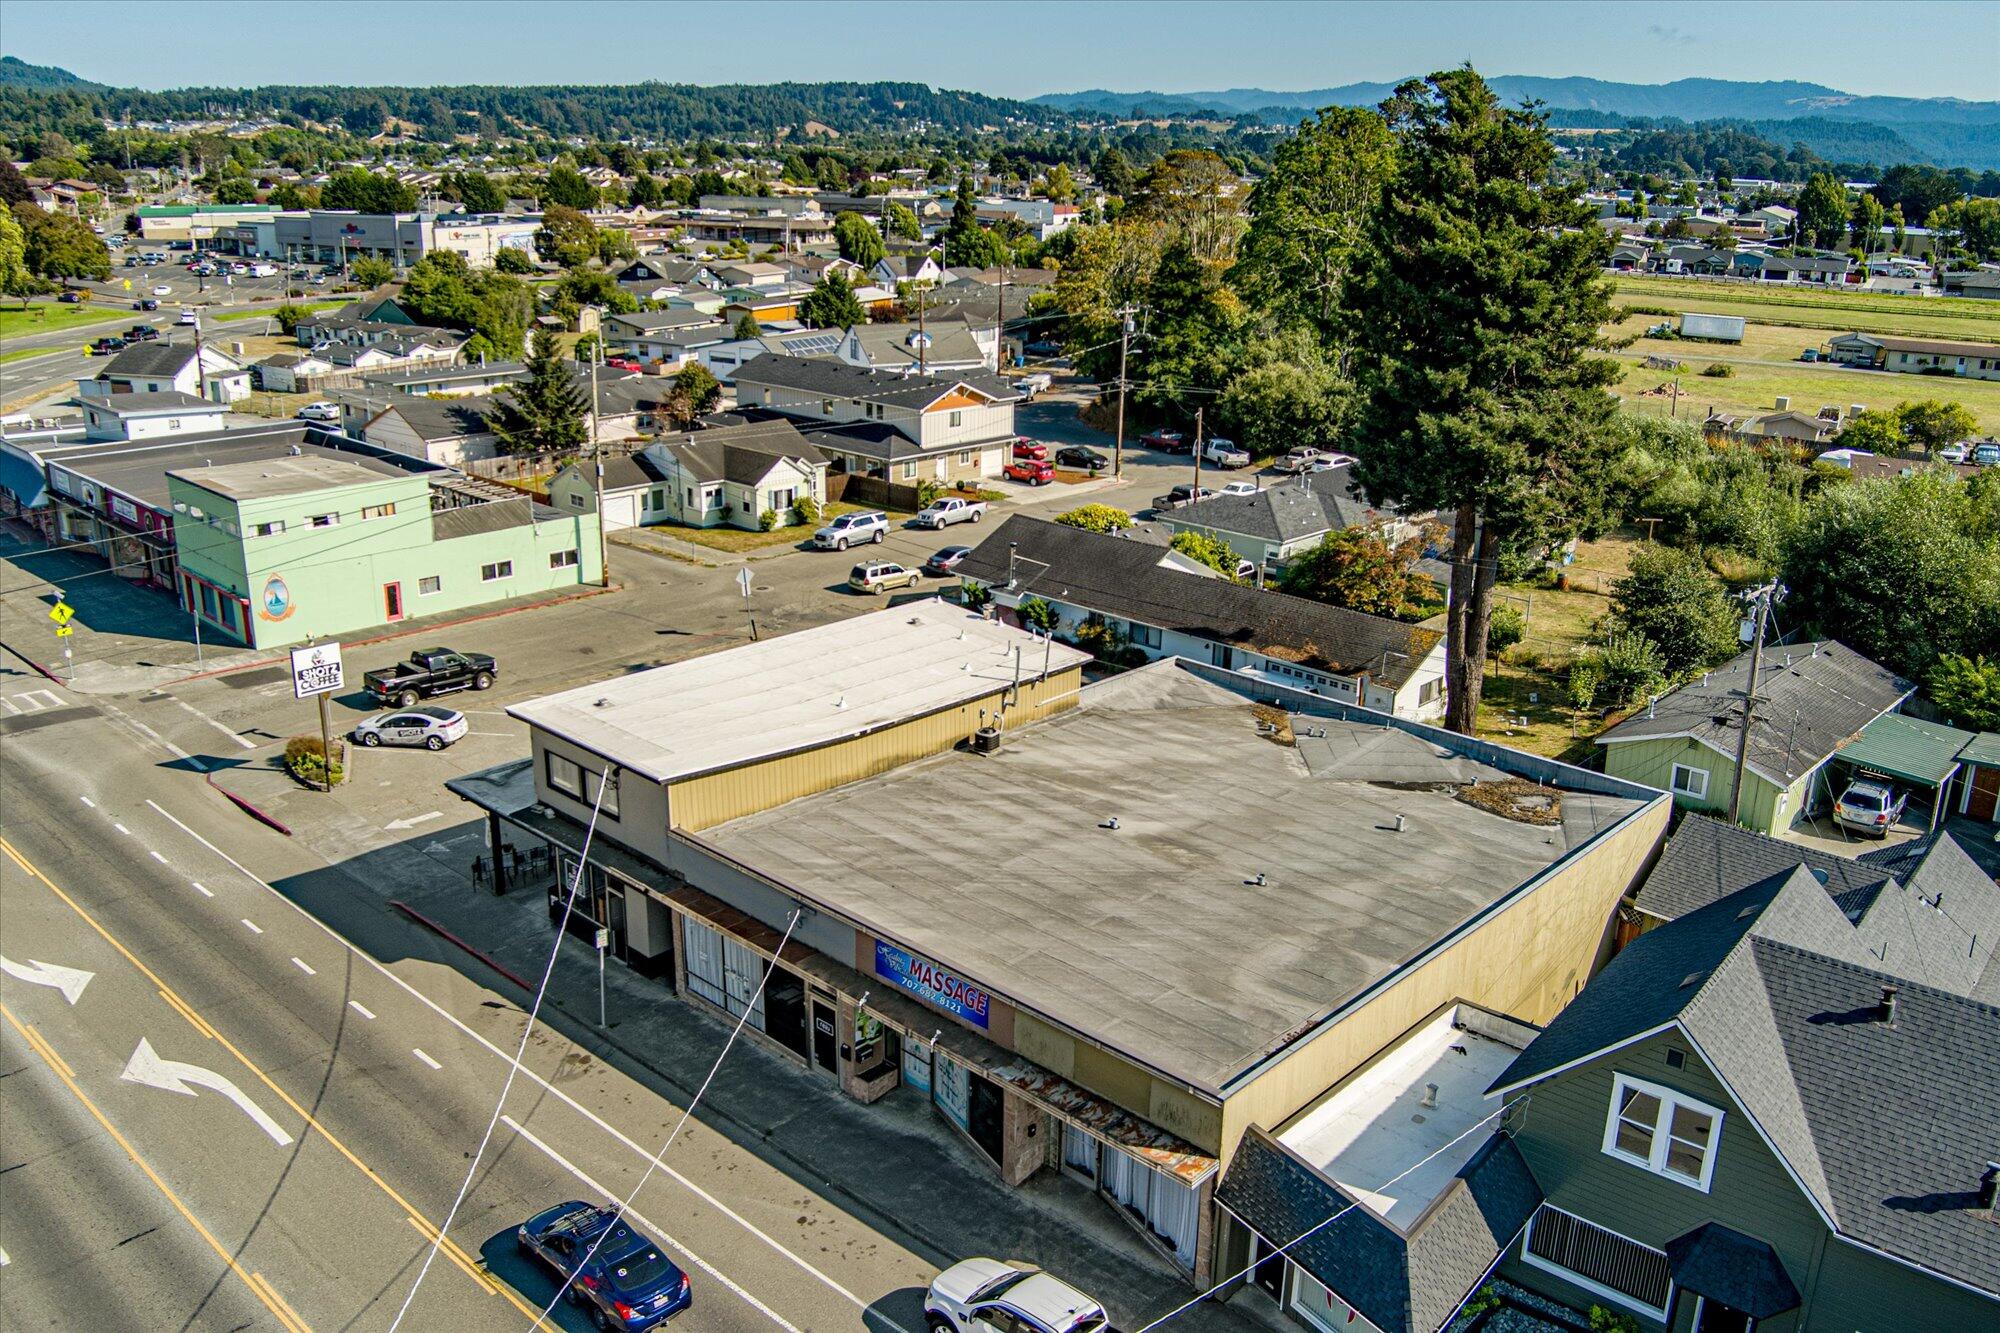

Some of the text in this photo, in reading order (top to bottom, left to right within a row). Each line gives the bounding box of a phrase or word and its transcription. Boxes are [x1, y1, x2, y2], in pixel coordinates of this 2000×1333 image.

[302, 663, 338, 680] SHOTZ
[301, 674, 340, 690] COFFEE
[909, 957, 988, 1016] MASSAGE
